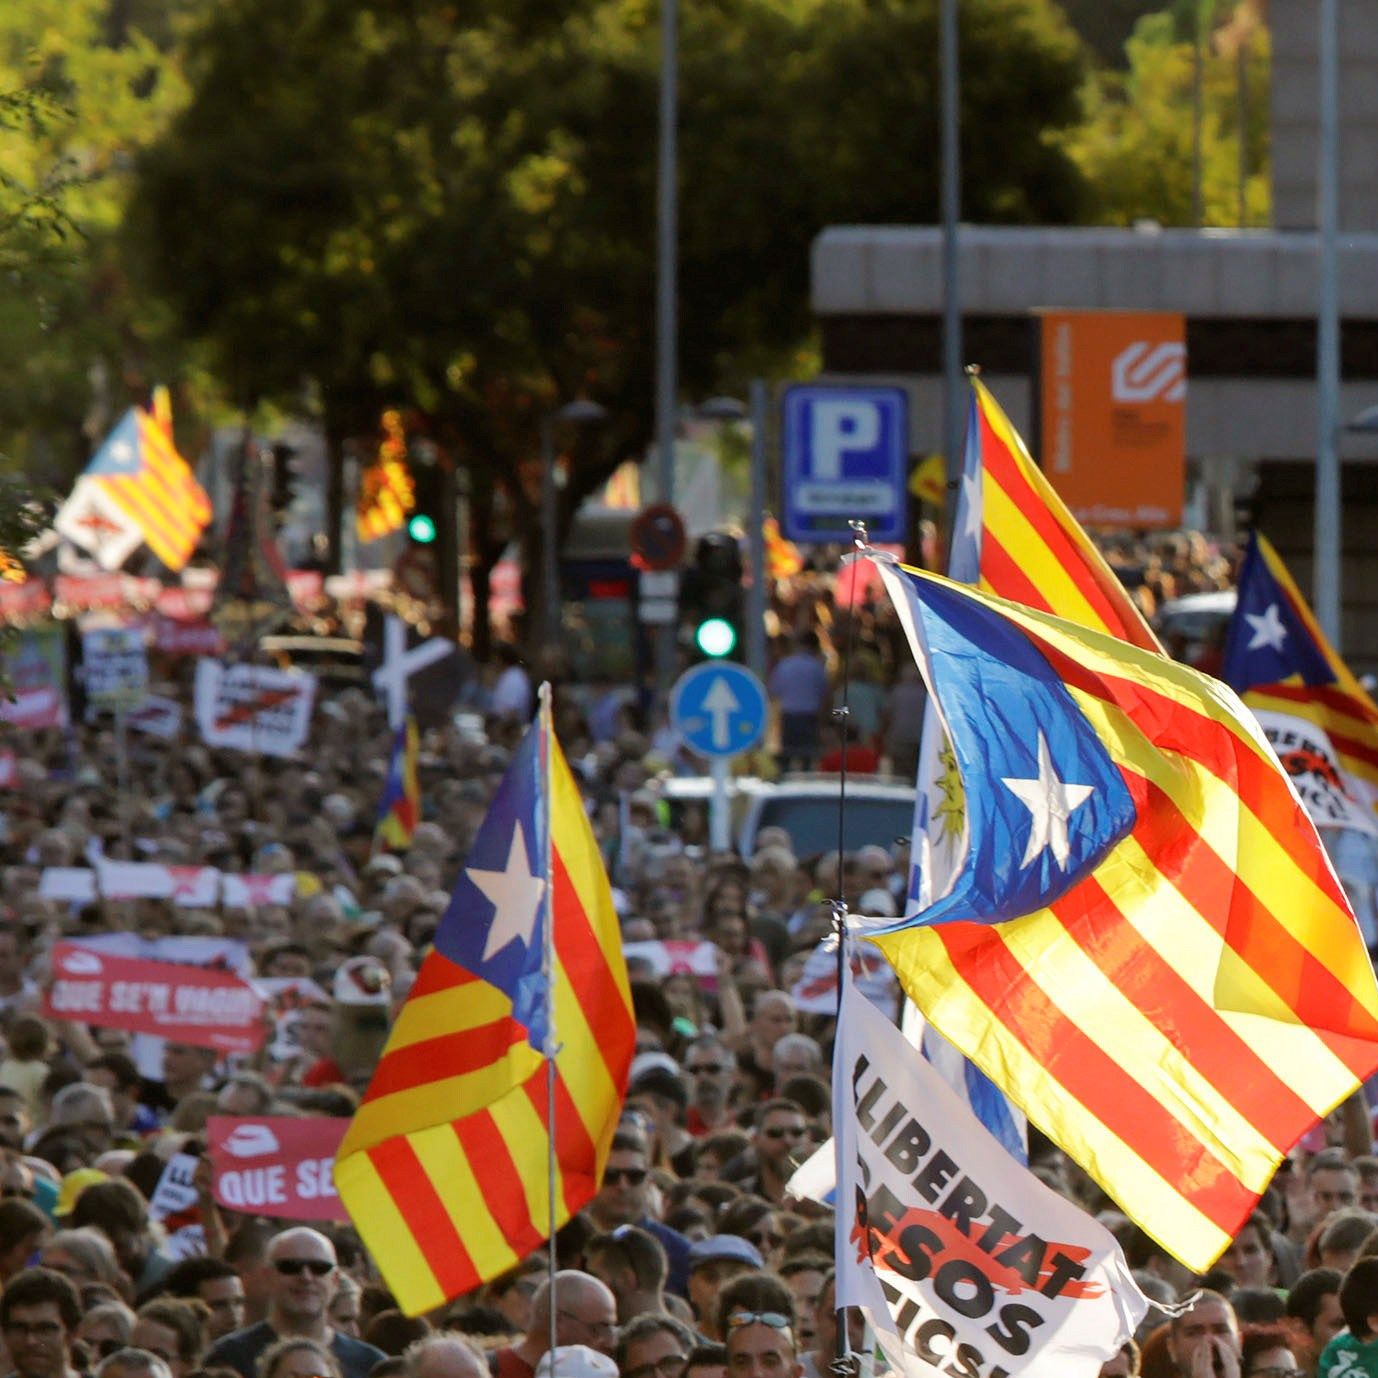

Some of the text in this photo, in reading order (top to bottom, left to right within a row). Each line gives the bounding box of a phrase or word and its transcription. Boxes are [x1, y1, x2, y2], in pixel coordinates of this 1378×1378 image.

[812, 400, 880, 480] P
[219, 1165, 287, 1205] QUE
[296, 1157, 337, 1198] SE
[852, 1053, 1087, 1301] LLIBERTAT
